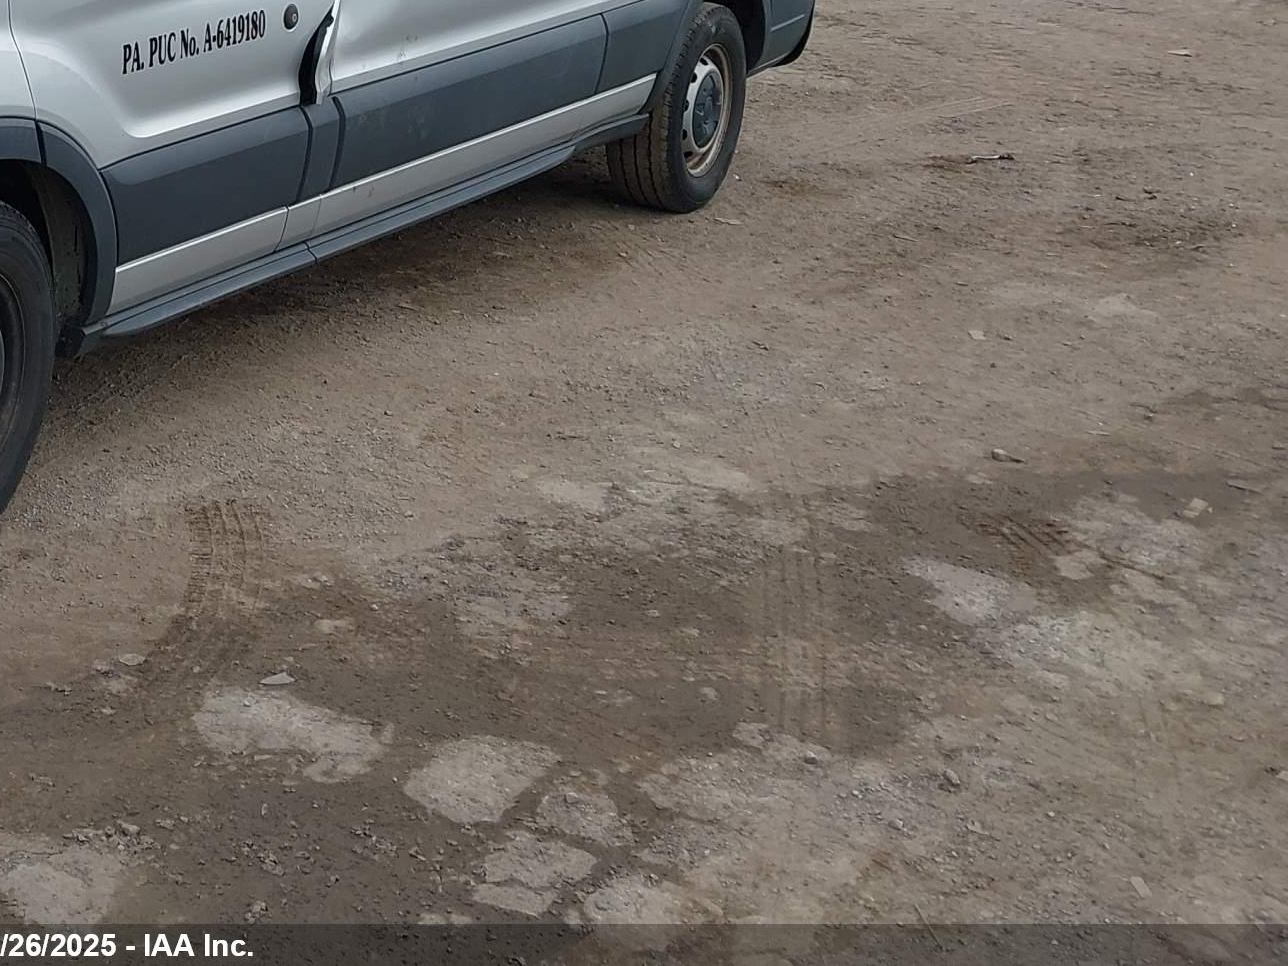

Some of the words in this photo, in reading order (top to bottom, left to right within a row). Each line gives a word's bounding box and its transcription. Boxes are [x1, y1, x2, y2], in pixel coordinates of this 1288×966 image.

[122, 42, 145, 75] PA.
[149, 32, 176, 68] PUC
[180, 28, 200, 59] No.
[203, 9, 266, 53] A-6419180
